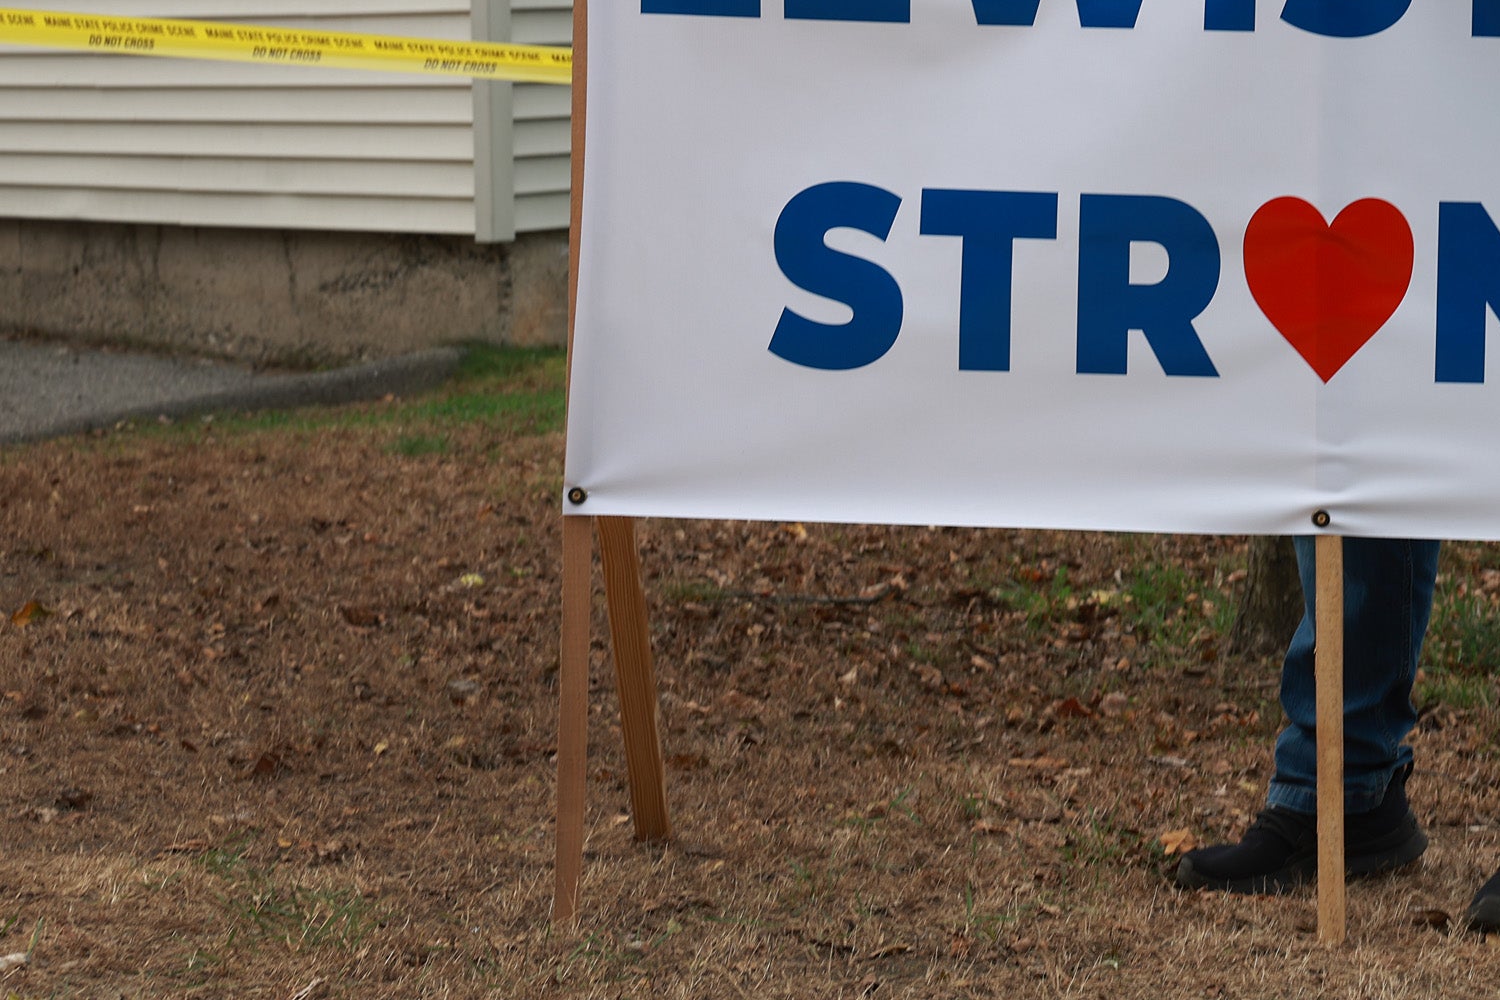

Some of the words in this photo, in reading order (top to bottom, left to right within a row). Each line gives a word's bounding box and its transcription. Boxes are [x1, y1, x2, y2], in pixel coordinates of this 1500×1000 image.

[136, 23, 164, 35] CRIME
[89, 34, 102, 47] DO
[103, 35, 122, 48] NOT
[124, 36, 155, 50] CROSS
[252, 45, 267, 58] DO
[268, 47, 288, 60] NOT
[289, 48, 322, 62] CROSS
[424, 58, 440, 70] DO
[441, 59, 461, 71] NOT
[463, 60, 498, 73] CROSS
